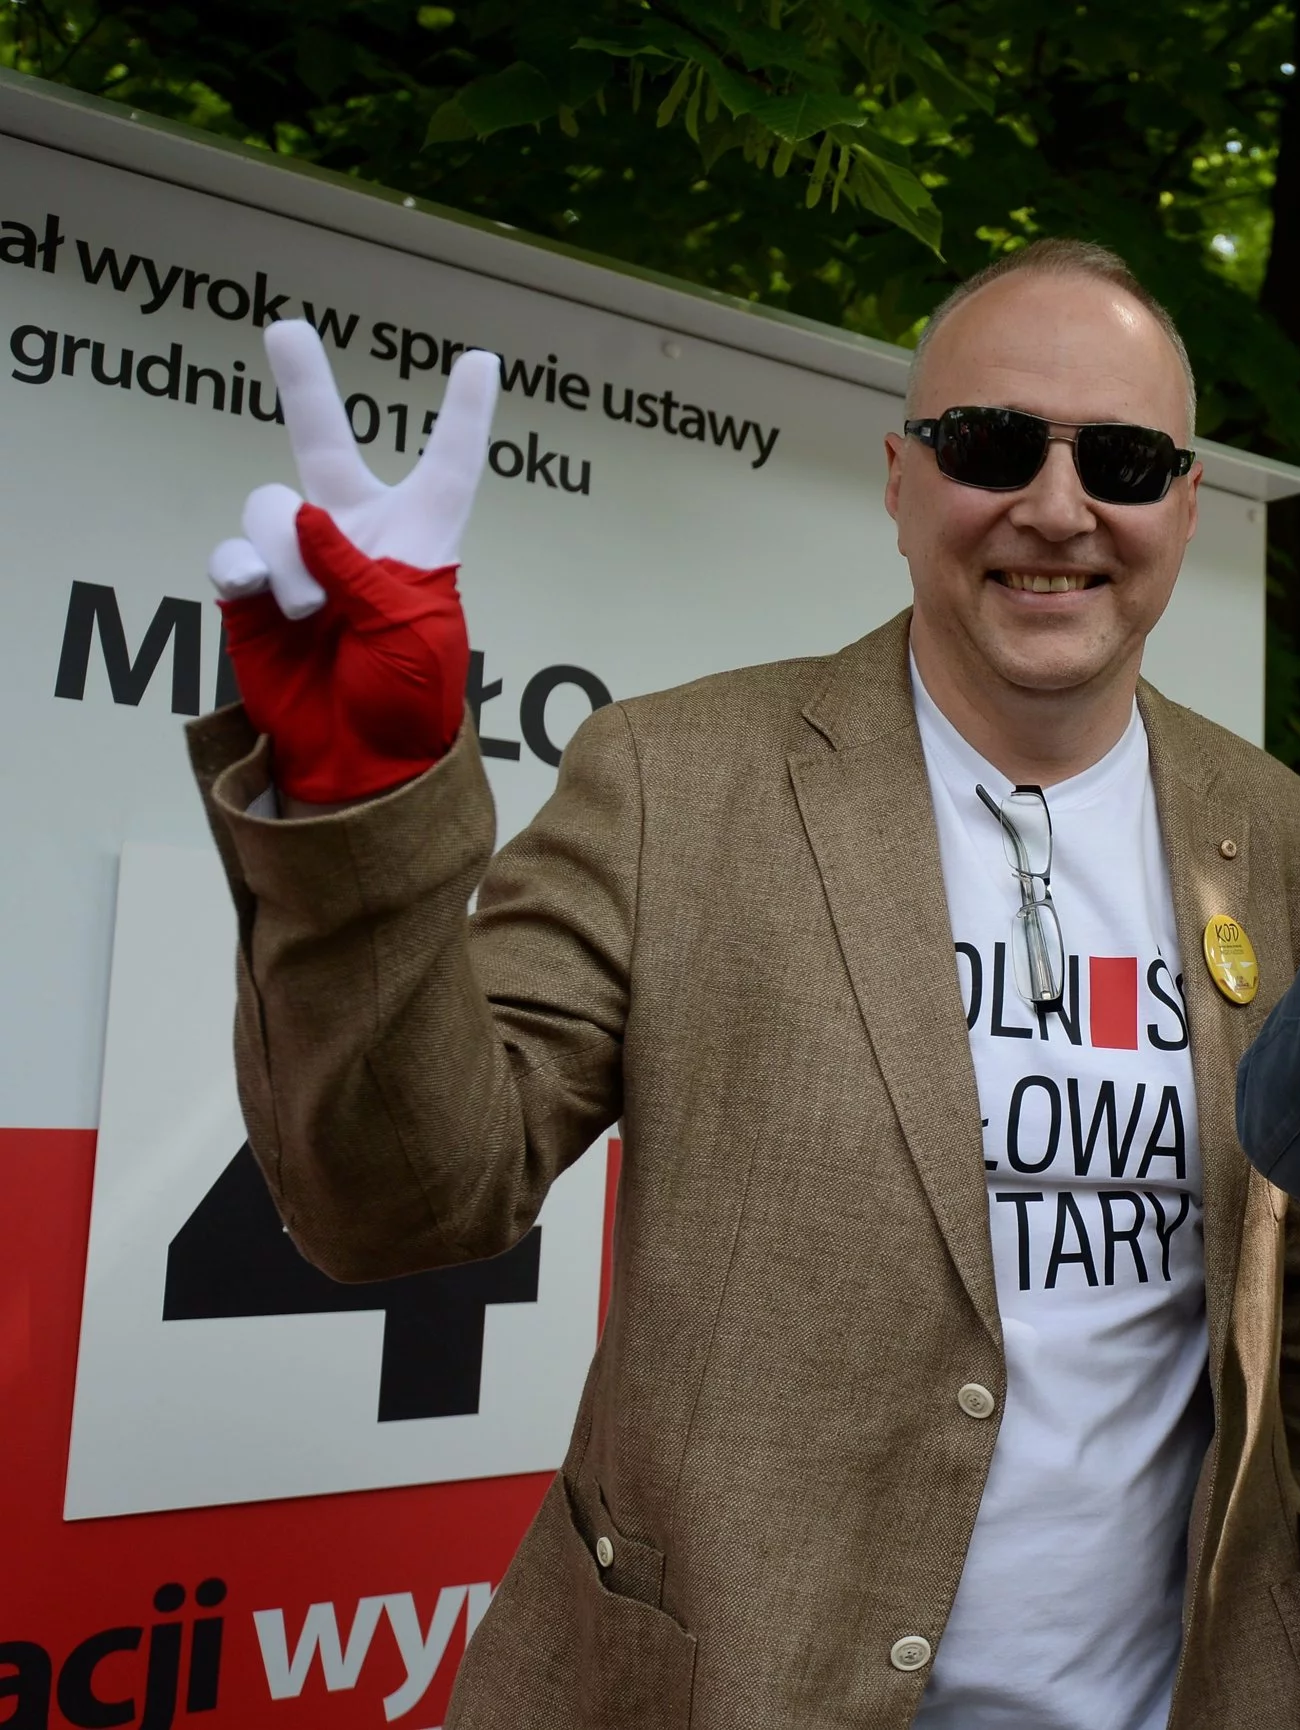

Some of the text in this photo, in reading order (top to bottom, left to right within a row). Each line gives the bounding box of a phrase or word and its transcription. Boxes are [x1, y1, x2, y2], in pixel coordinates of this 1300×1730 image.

[0, 213, 780, 470] ał wyrok w sprwie ustawy
[488, 431, 592, 496] oku
[1215, 923, 1239, 943] KOD
[996, 1190, 1190, 1291] TARY
